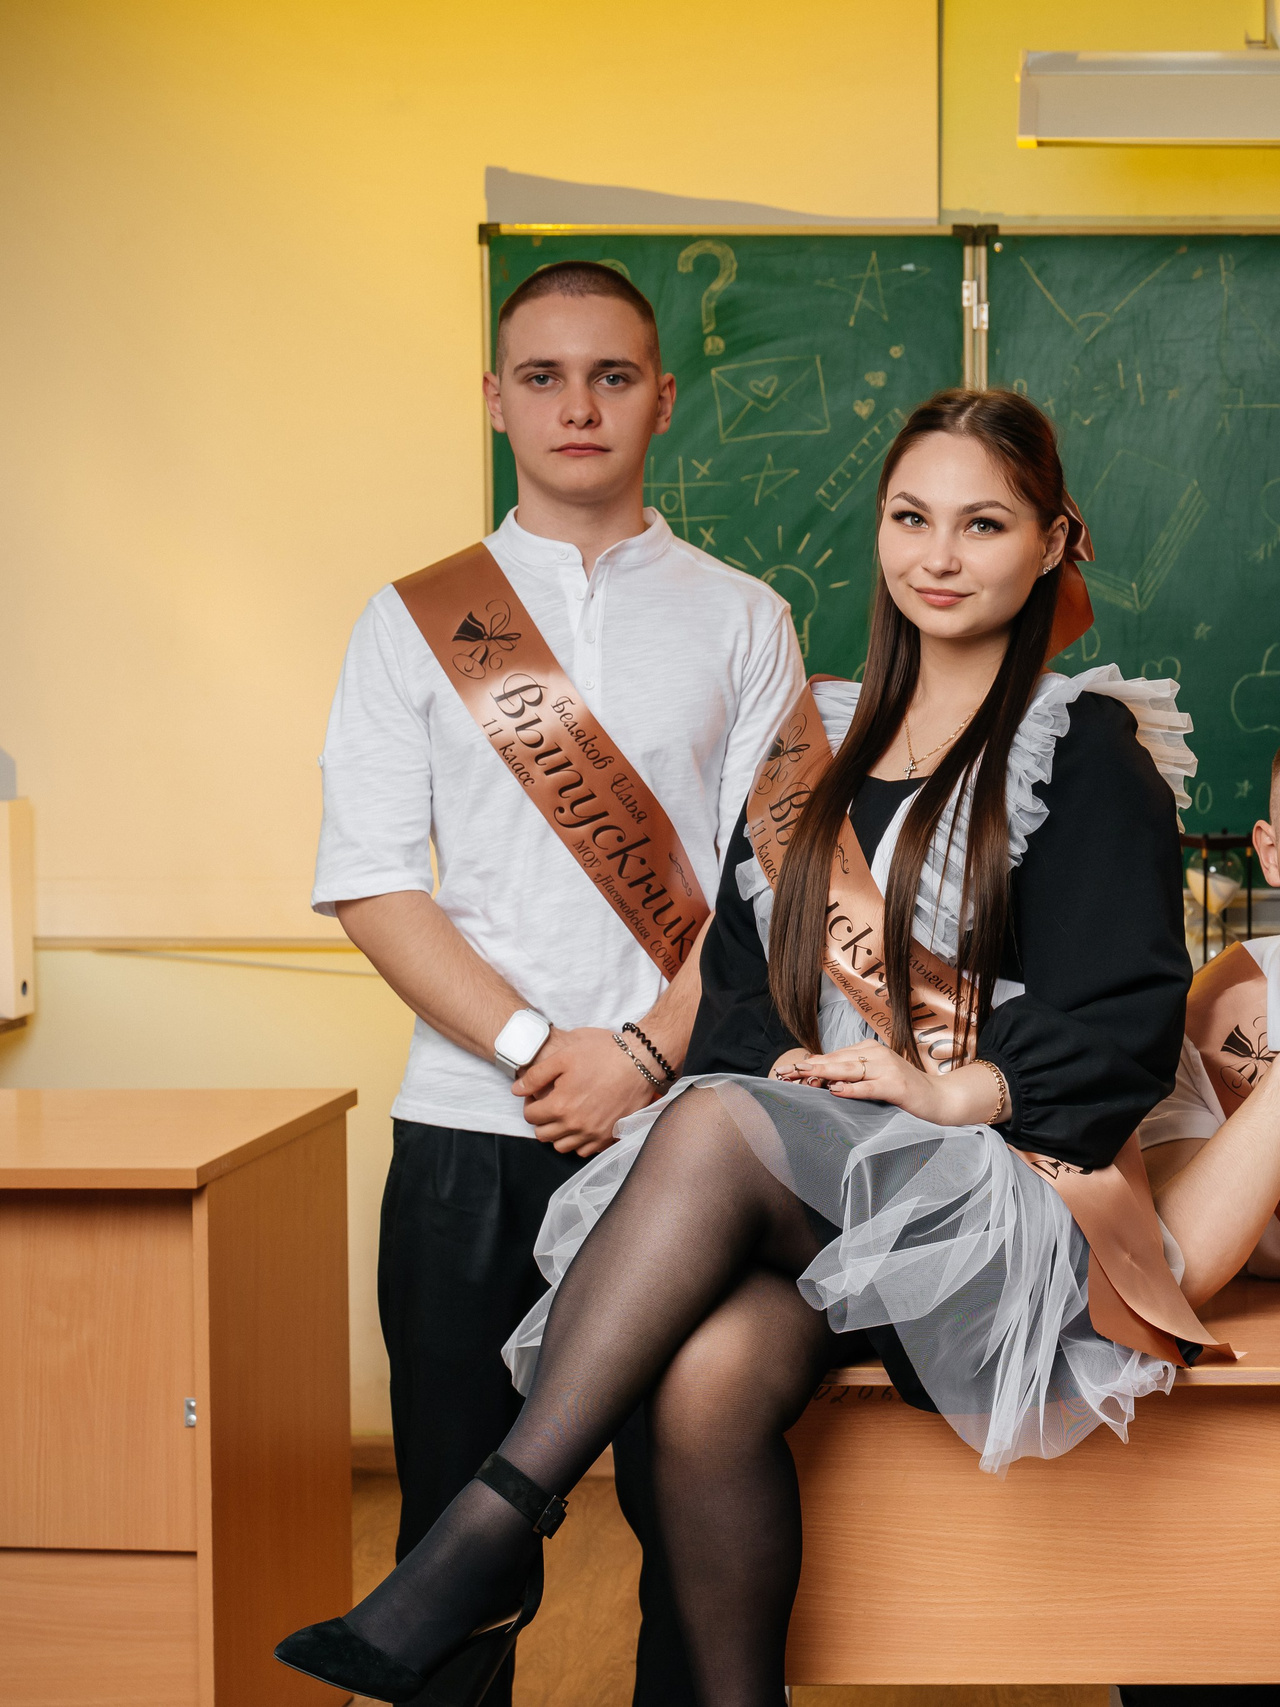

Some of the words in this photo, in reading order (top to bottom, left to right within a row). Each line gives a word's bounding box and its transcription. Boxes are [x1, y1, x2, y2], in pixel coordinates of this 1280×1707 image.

[482, 718, 504, 739] 11
[499, 741, 535, 788] класс
[551, 695, 615, 770] Беляков
[489, 673, 697, 964] Выпускник
